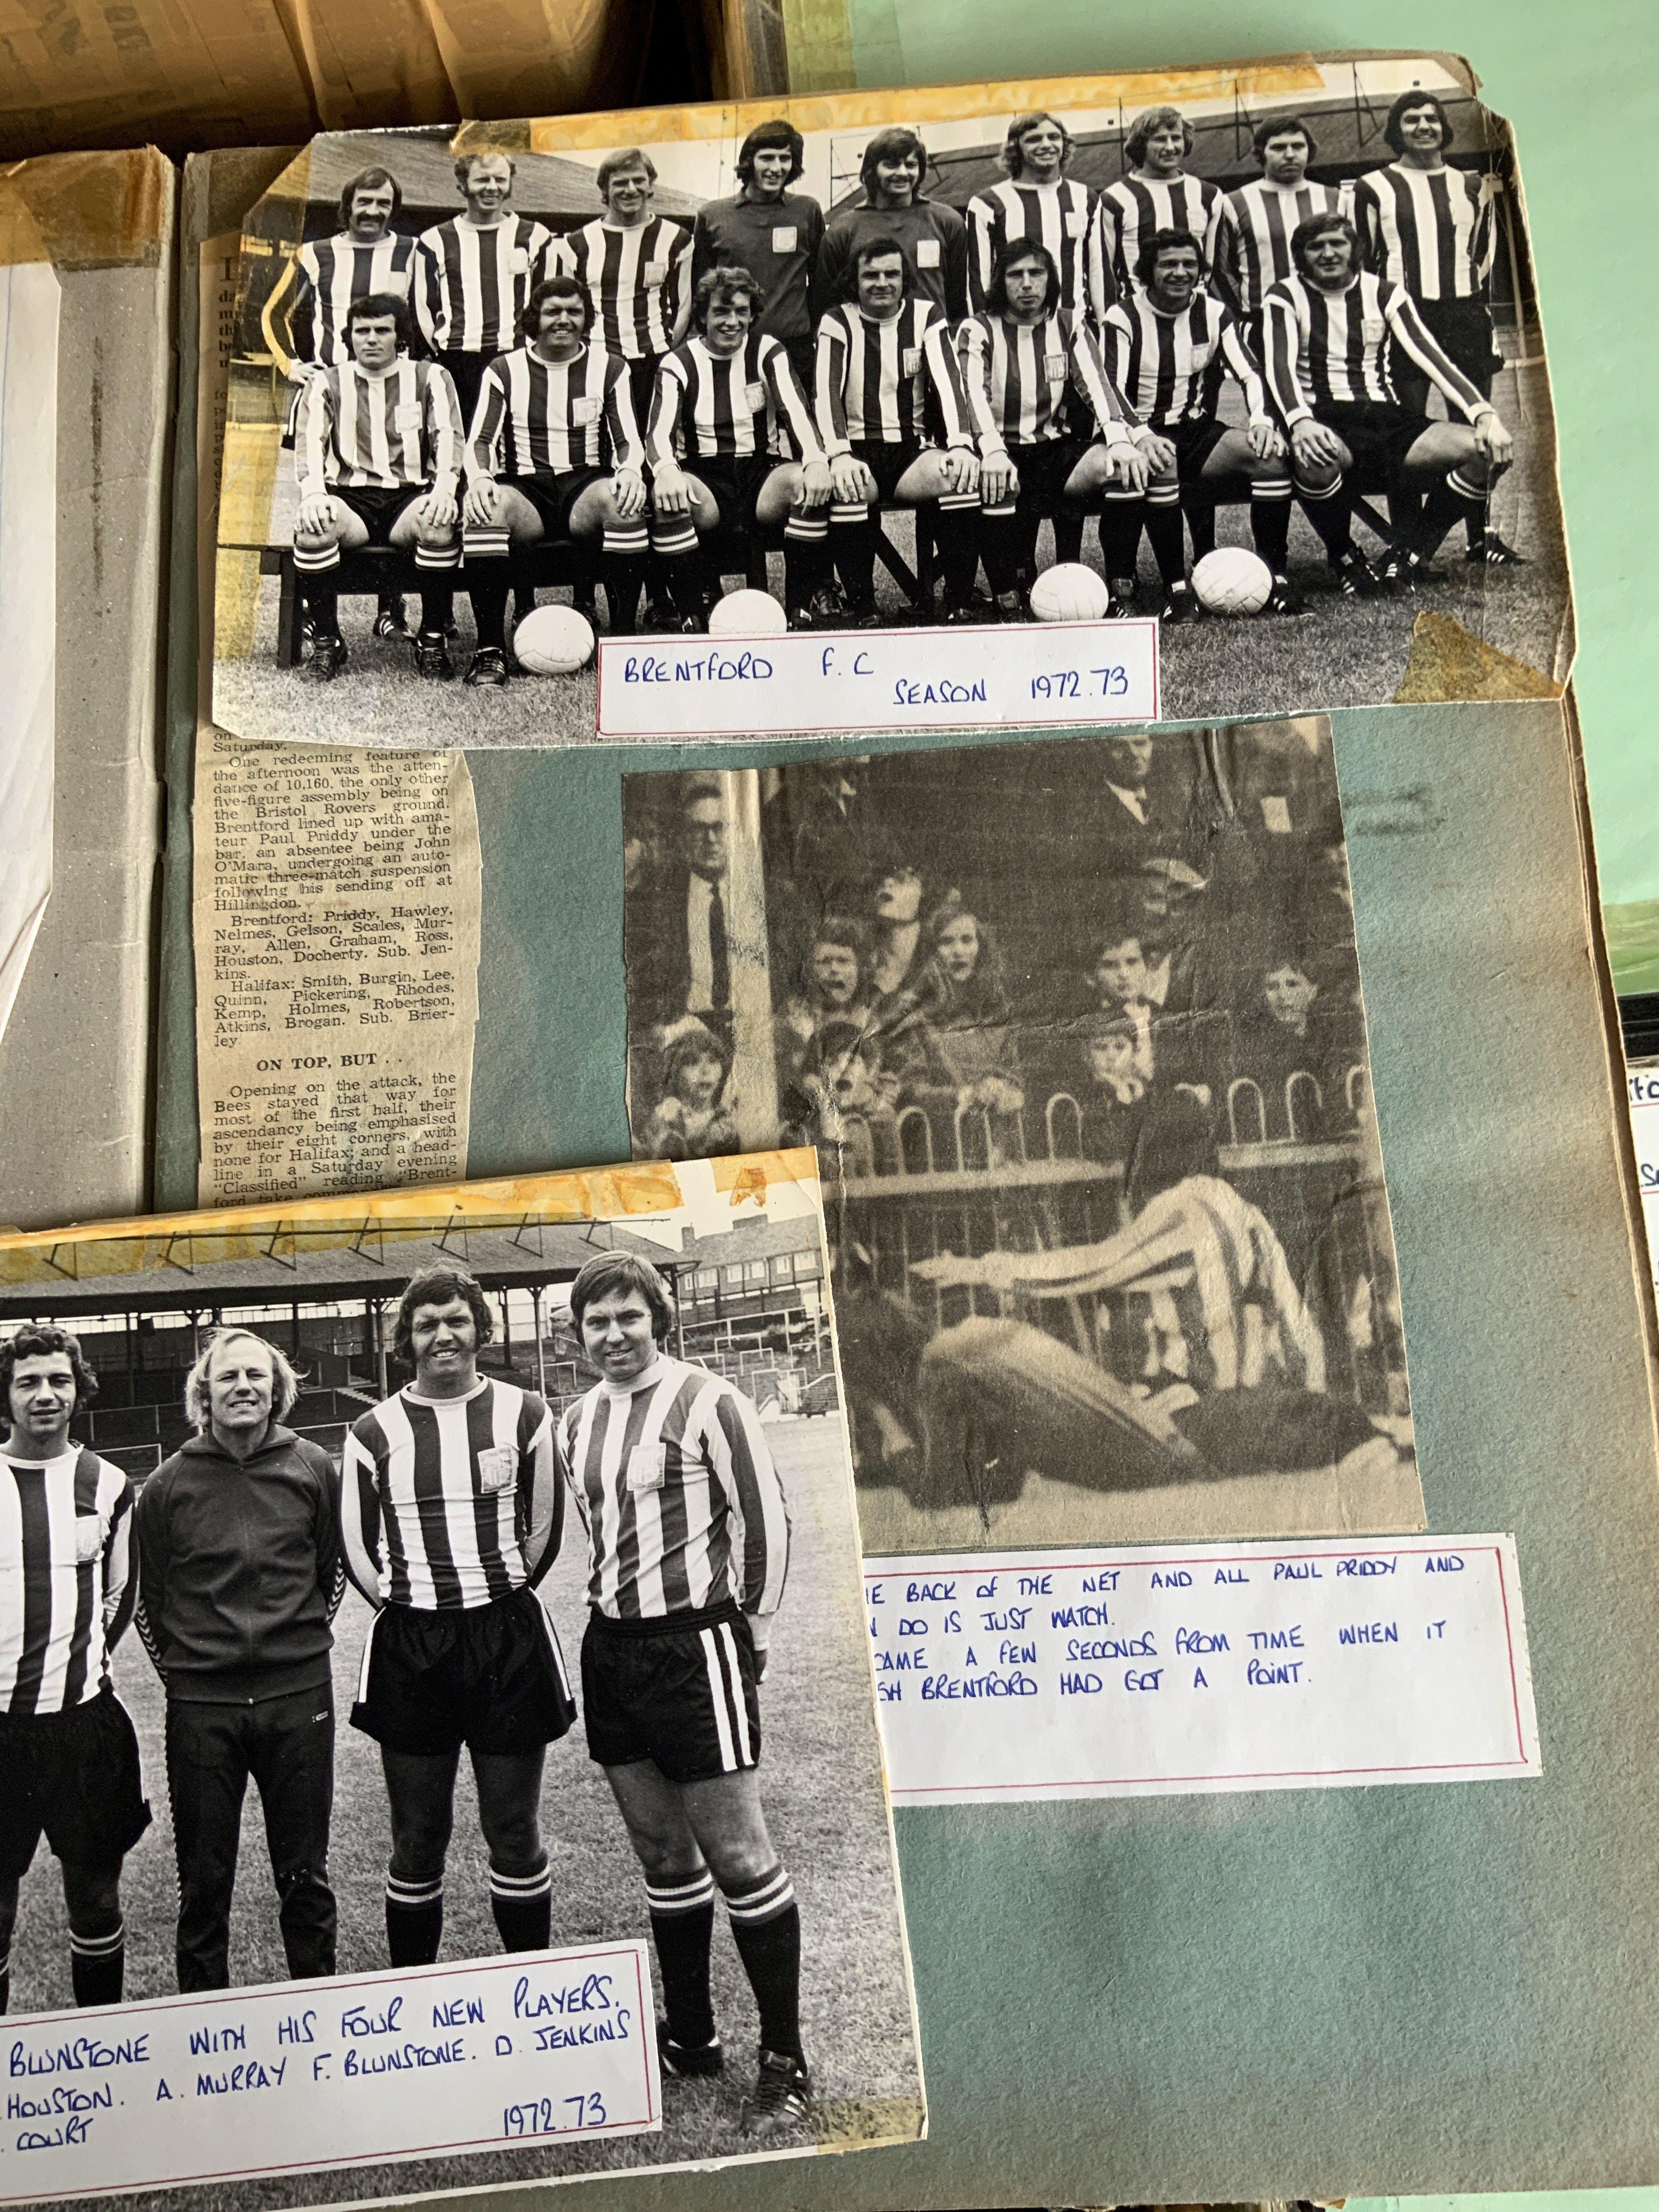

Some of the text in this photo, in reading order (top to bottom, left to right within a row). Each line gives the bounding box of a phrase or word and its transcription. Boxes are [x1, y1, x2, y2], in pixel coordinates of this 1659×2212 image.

[625, 652, 772, 682] BRENTFORD
[893, 679, 987, 704] SEASON
[228, 749, 421, 767] One redeeming feature
[213, 761, 448, 781] the afternoon was the atten-
[263, 773, 448, 791] of the only other
[213, 787, 448, 808] five-figure assembly being on
[213, 798, 449, 820] the Bristol Rovers ground.
[215, 811, 449, 834] Brentford lined up with ama-
[215, 822, 452, 847] teur Paul Priddy under the
[256, 837, 450, 857] an absentee being John
[288, 850, 450, 870] undergoing an auto-
[215, 863, 451, 884] matic three-match suspension
[215, 874, 453, 898] following his sending off at
[214, 899, 301, 911] Hillingdon.
[230, 912, 313, 927] Brentford:
[414, 918, 453, 929] Mur-
[377, 945, 410, 958] Sub.
[420, 944, 453, 956] Jen-
[284, 1017, 346, 1030] Brogan.
[360, 1012, 392, 1025] Sub.
[256, 1053, 377, 1071] ON TOP, BUT
[229, 1084, 297, 1099] Opening
[306, 1084, 325, 1092] on
[336, 1079, 360, 1091] the
[431, 1073, 456, 1084] the
[213, 1086, 456, 1113] Bees stayed that way for
[214, 1114, 252, 1126] most
[263, 1111, 280, 1122] of
[291, 1108, 317, 1120] the
[330, 1106, 362, 1118] first
[419, 1100, 456, 1111] their
[213, 1112, 456, 1140] ascendancy being emphasised
[213, 1126, 456, 1154] by their eight with
[213, 1139, 456, 1167] none for and a head-
[213, 1155, 457, 1181] line in a Saturday evening
[323, 1173, 385, 1188] reading
[906, 1581, 956, 1602] BACK
[1017, 1575, 1053, 1595] THE
[1083, 1571, 1120, 1592] NET
[1151, 1571, 1192, 1589] AND
[1214, 1568, 1250, 1584] ALL
[1274, 1562, 1322, 1580] PAUL
[1336, 1556, 1396, 1576] PRIDDY
[1425, 1555, 1464, 1573] AND
[899, 1618, 928, 1635] DO
[945, 1610, 961, 1633] IS
[980, 1607, 1032, 1630] JUST
[966, 1646, 978, 1666] A
[1000, 1640, 1036, 1664] FEW
[1066, 1631, 1158, 1661] SECONDS
[1176, 1627, 1230, 1655] FROM
[1249, 1625, 1305, 1650] TIME
[1339, 1622, 1398, 1644] WHEN
[1427, 1620, 1446, 1639] IT
[922, 1671, 1037, 1700] BRENTFORD
[1060, 1672, 1103, 1695] HAD
[1125, 1669, 1164, 1691] GOT
[1194, 1667, 1208, 1688] A
[10, 2034, 149, 2077] BLUNSTONE
[190, 2024, 246, 2055] WITH
[279, 2011, 316, 2045] HIS
[342, 1996, 403, 2038] FOUR
[433, 1996, 485, 2028] NEW
[197, 2059, 286, 2095] MURRAY
[534, 2008, 630, 2052] JENKINS
[17, 2115, 92, 2151] COURT
